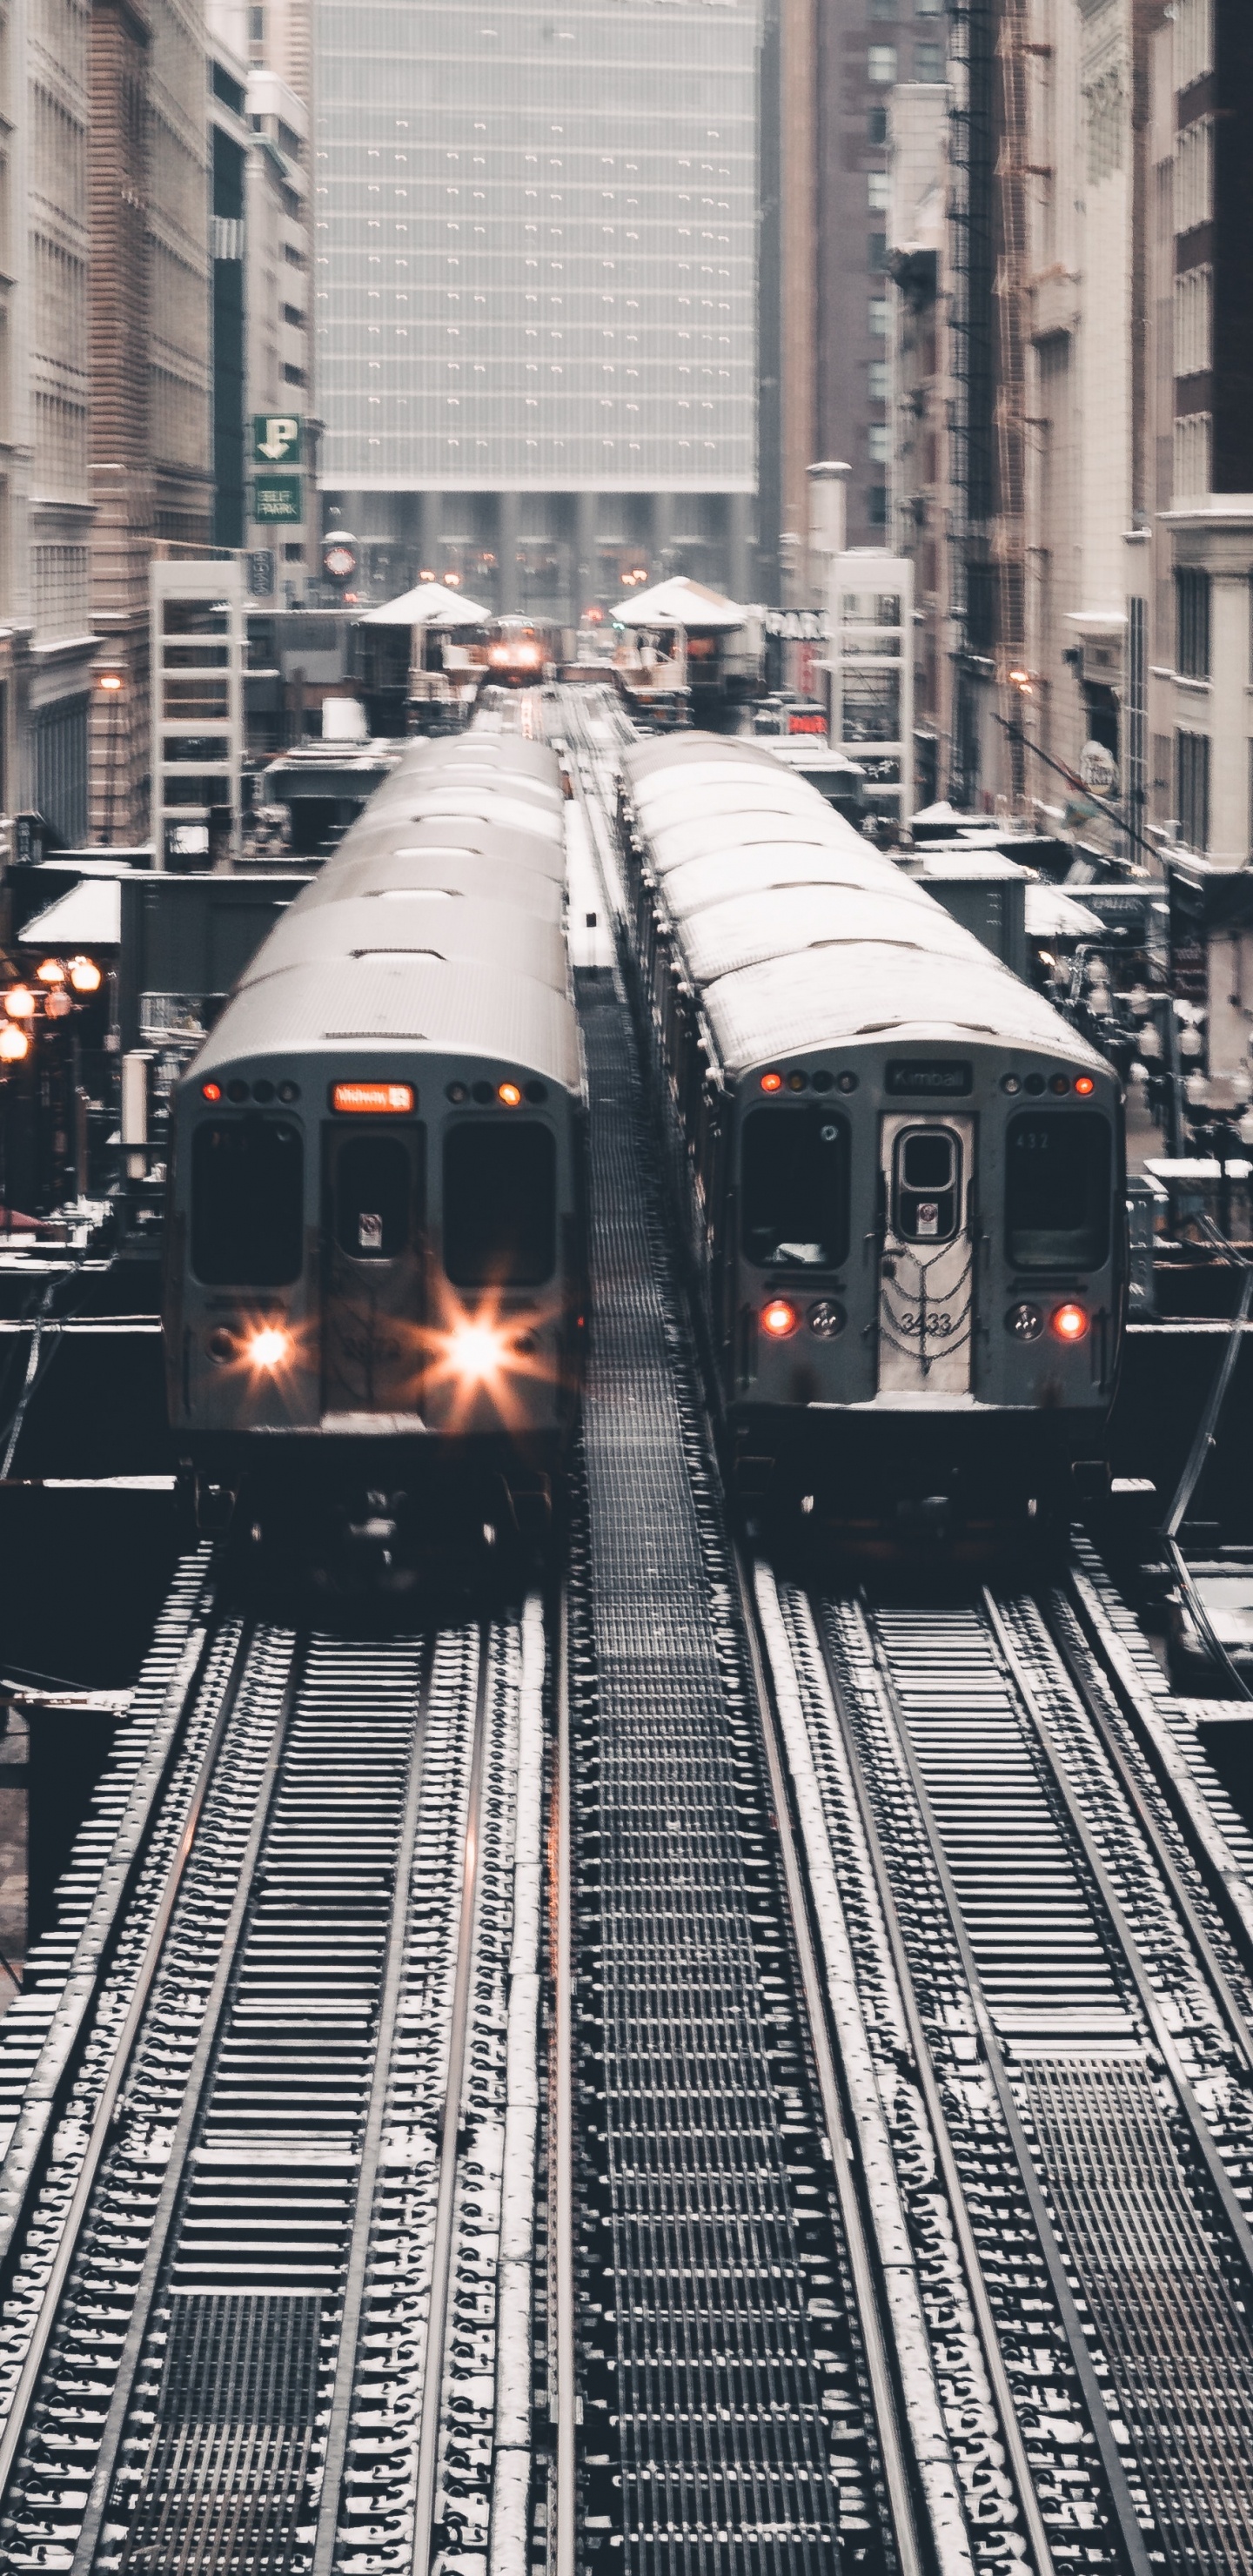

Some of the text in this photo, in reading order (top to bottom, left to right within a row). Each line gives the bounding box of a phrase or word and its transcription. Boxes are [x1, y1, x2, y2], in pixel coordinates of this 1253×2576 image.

[265, 419, 298, 449] P
[258, 503, 297, 514] PARK
[901, 1312, 952, 1332] 3433
